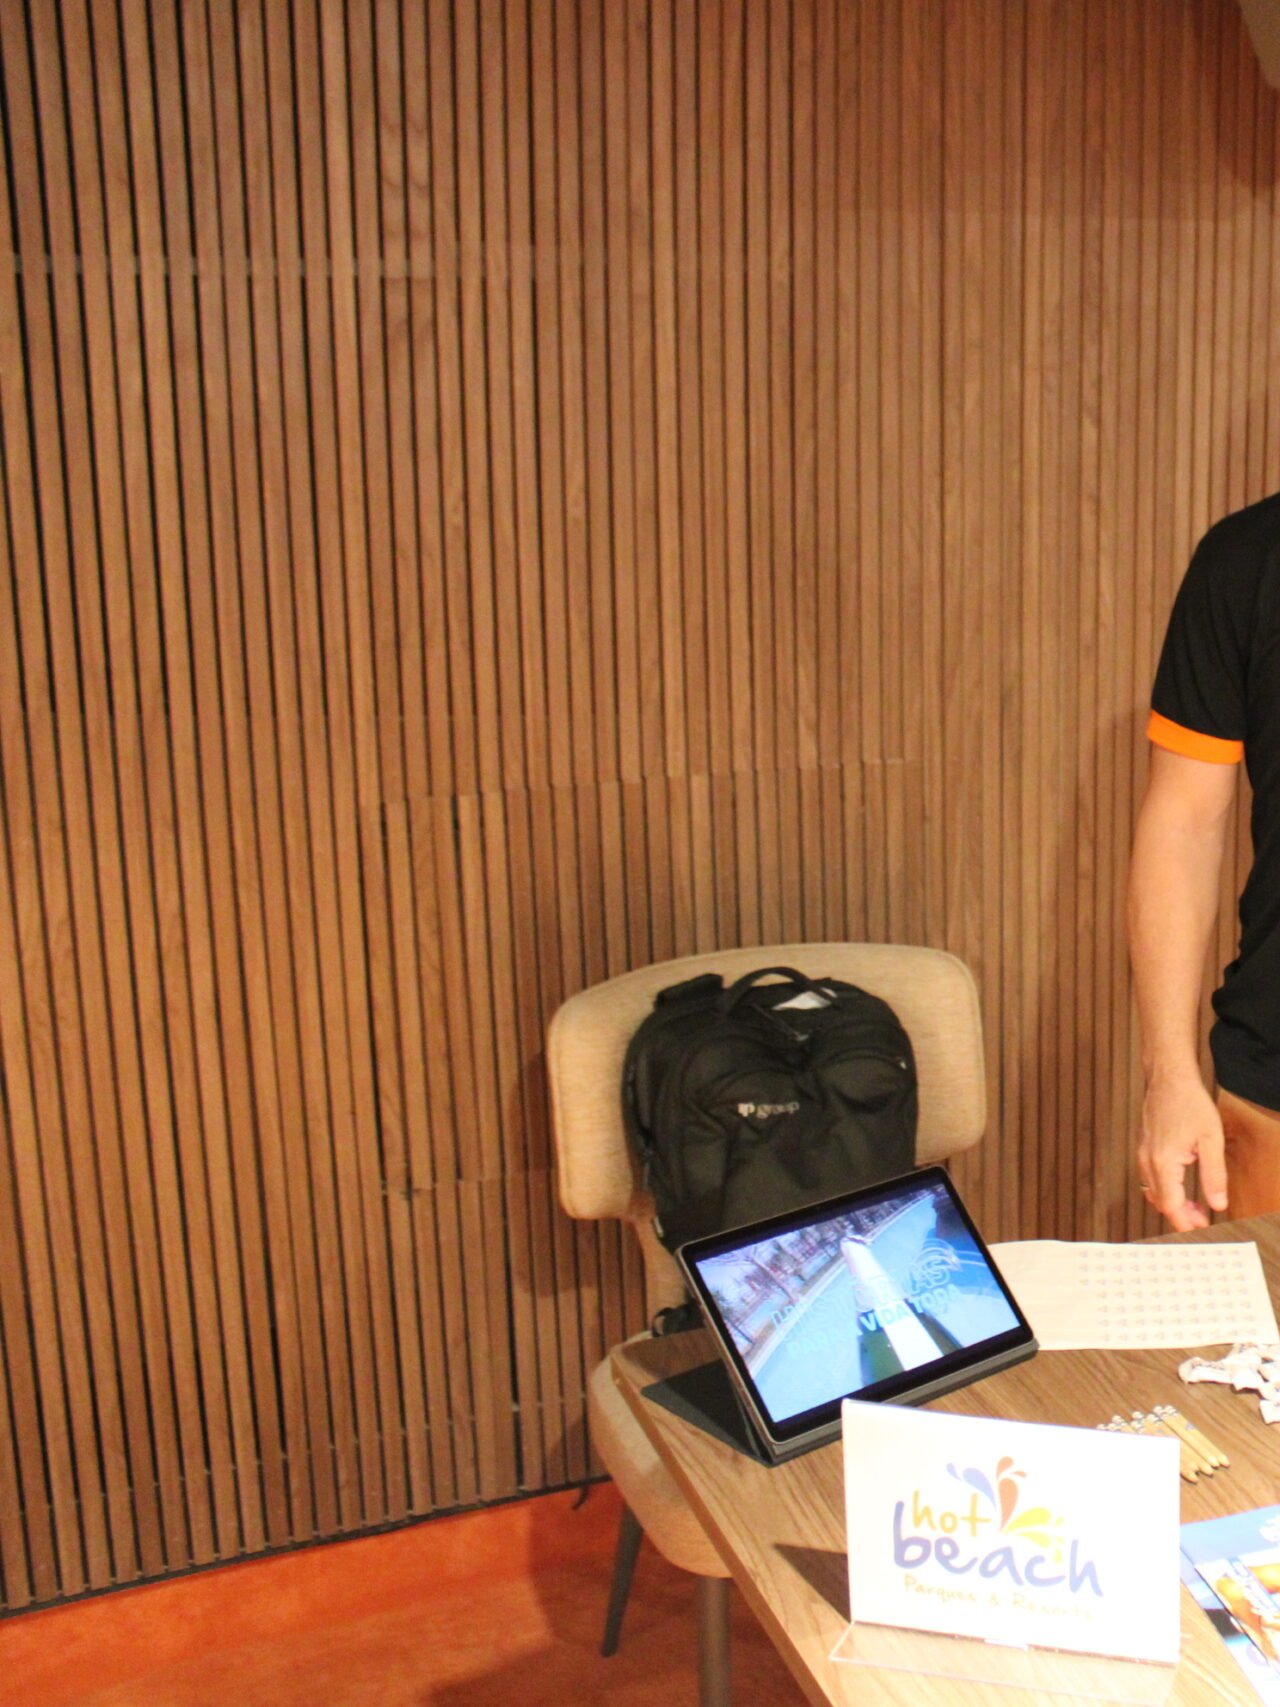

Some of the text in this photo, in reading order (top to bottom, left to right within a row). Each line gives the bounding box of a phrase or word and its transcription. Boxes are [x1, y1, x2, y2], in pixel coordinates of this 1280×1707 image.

[858, 1300, 911, 1334] VIDA
[908, 1281, 962, 1316] TODA
[912, 1490, 991, 1538] hot
[893, 1501, 1104, 1597] beach
[903, 1573, 976, 1604] Parques
[987, 1593, 1000, 1607] &
